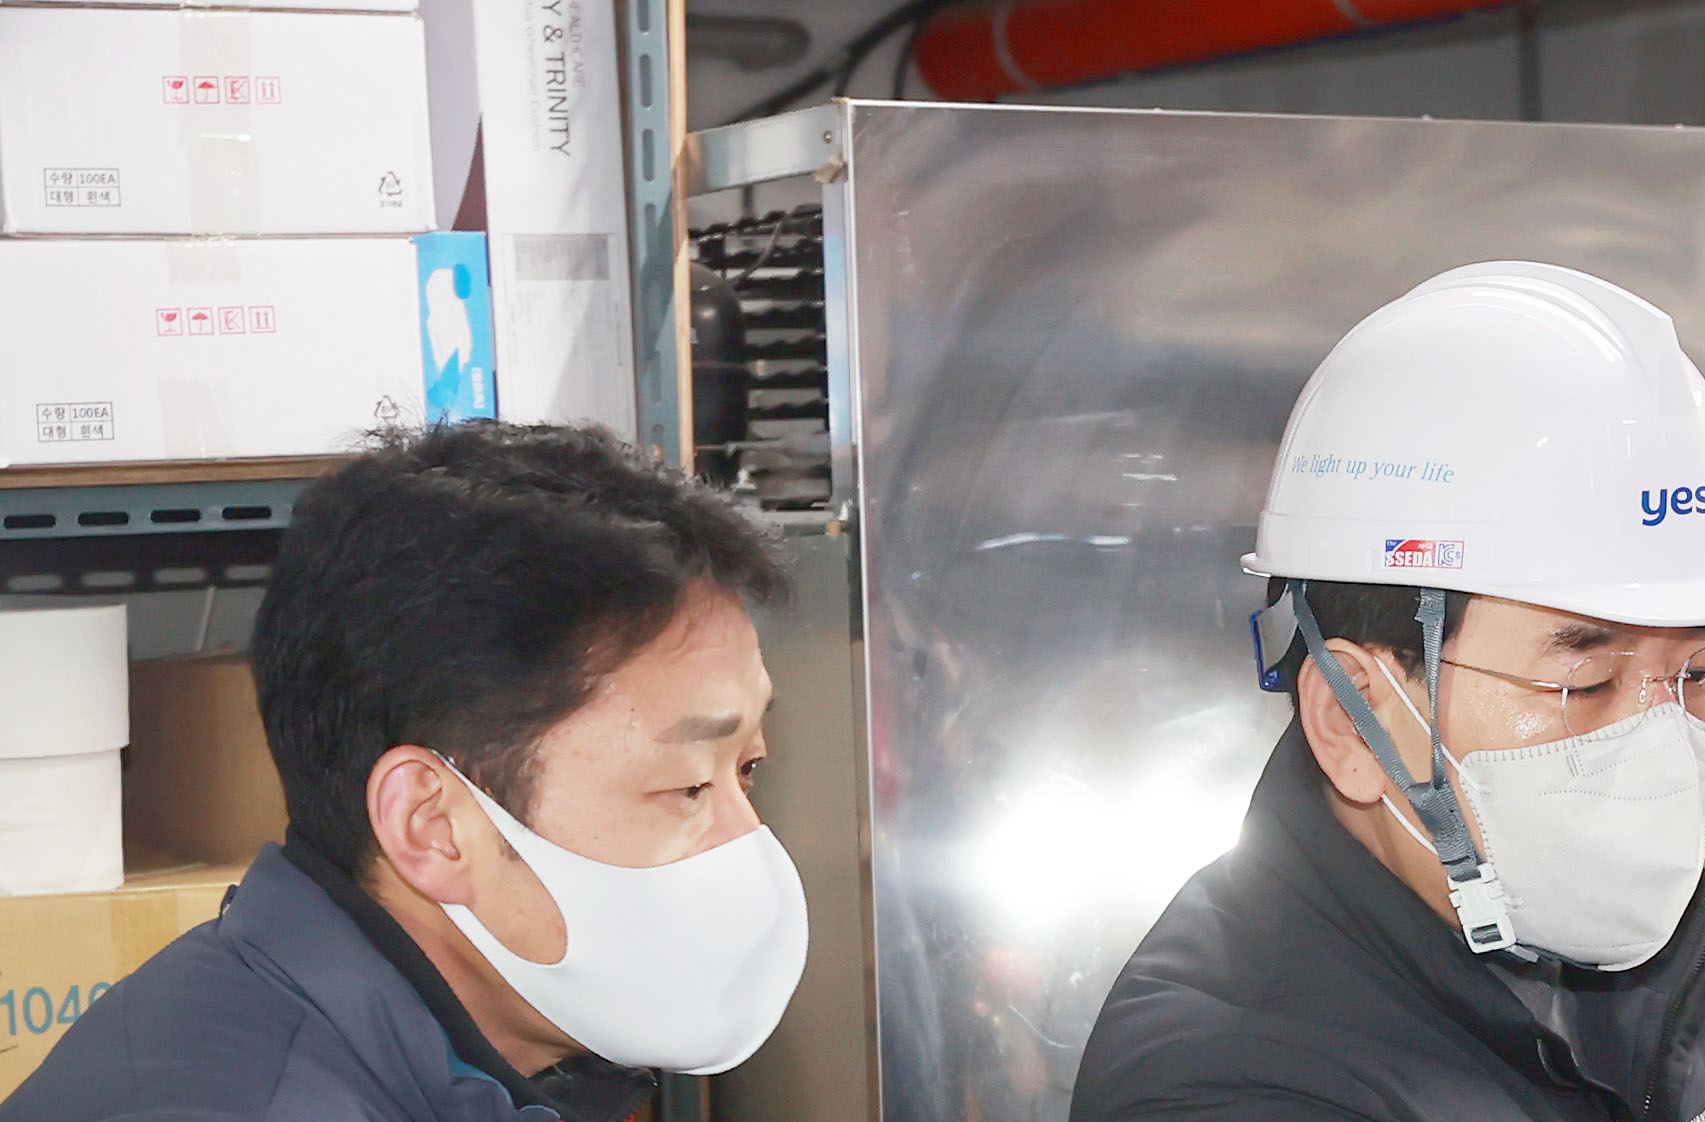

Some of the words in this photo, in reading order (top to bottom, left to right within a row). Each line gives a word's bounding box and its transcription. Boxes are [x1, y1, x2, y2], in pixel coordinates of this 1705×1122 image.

[543, 25, 564, 43] &
[545, 52, 571, 157] TRINITY
[50, 171, 73, 186] 수량
[80, 173, 117, 185] 100EA
[42, 407, 66, 421] 수량
[72, 407, 109, 419] 100EA
[43, 425, 66, 439] 대형
[1309, 454, 1342, 478] light
[1346, 460, 1367, 480] up
[1369, 461, 1416, 481] your
[1421, 461, 1455, 483] life
